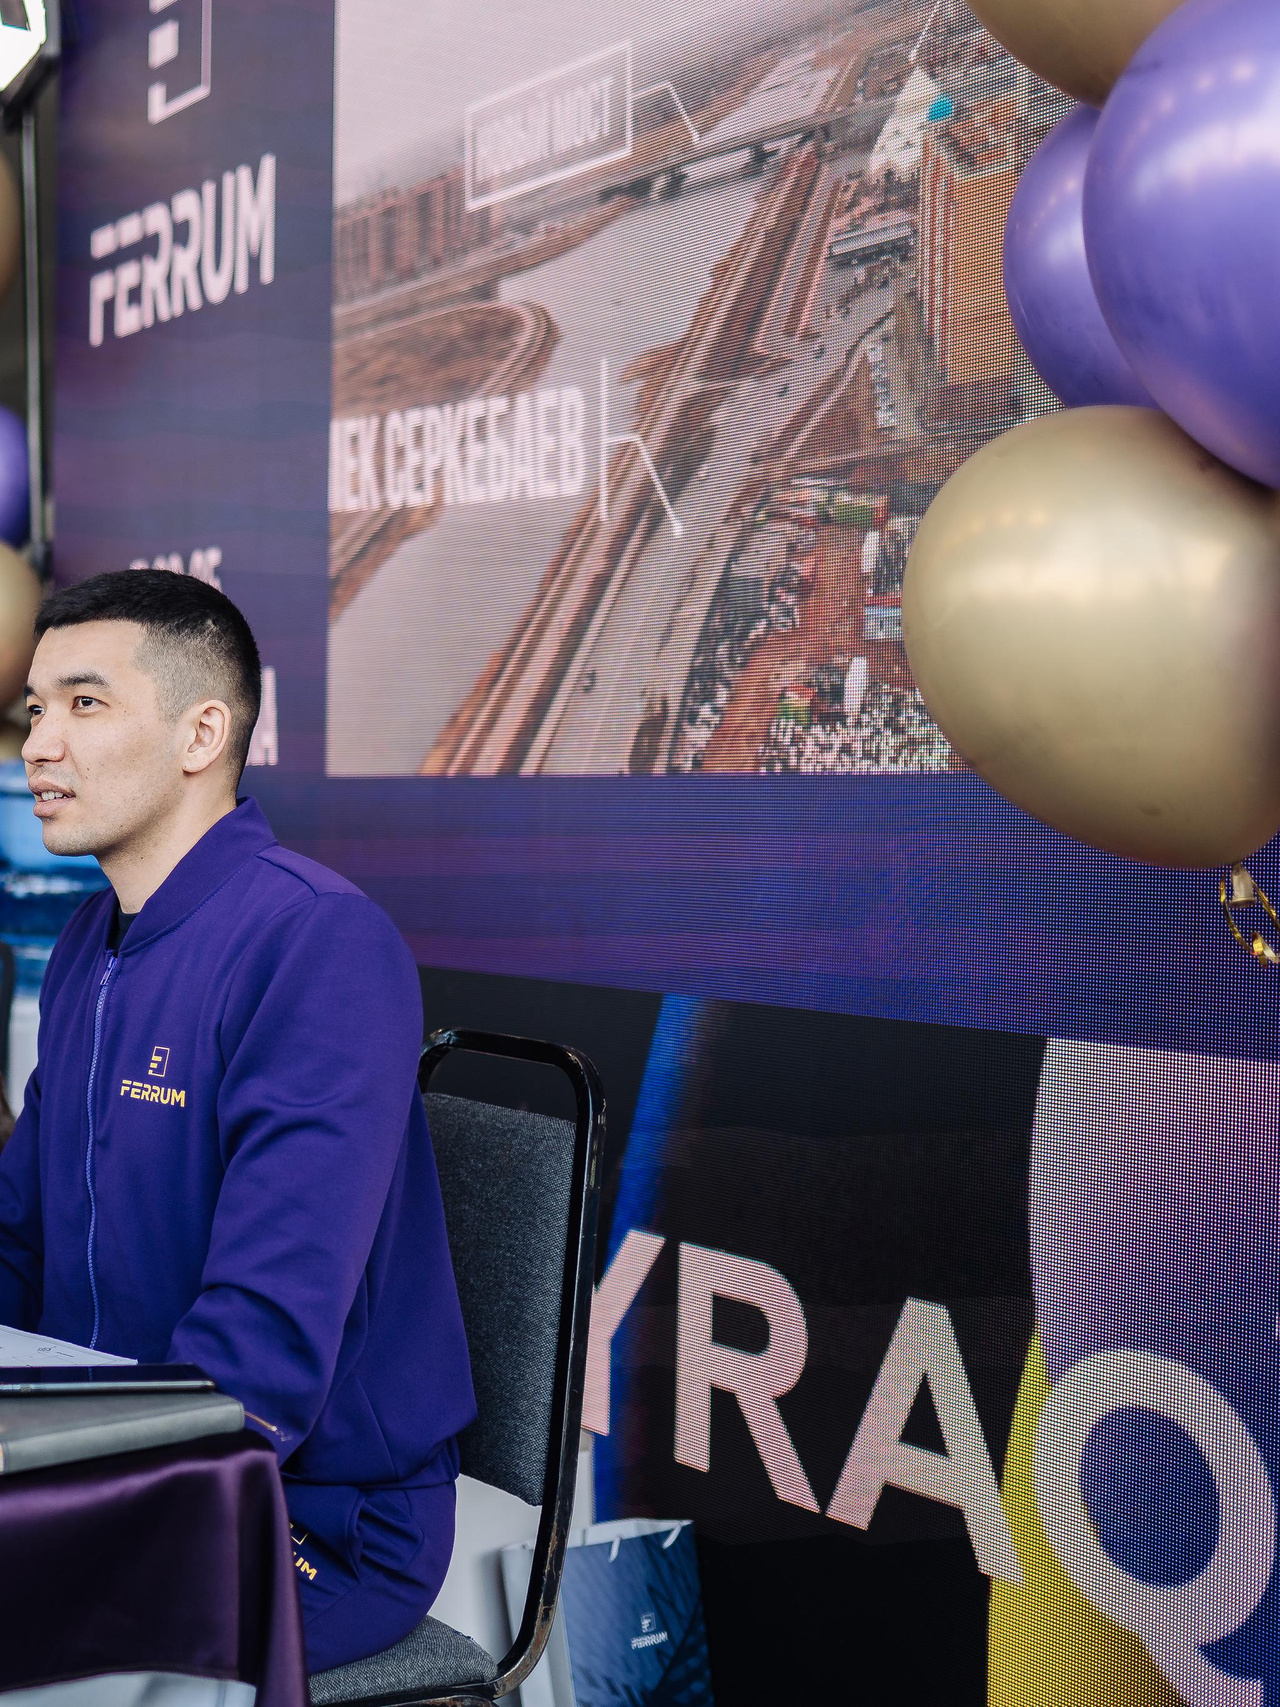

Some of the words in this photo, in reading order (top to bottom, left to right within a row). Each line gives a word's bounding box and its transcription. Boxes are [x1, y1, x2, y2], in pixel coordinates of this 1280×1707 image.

[552, 75, 614, 156] МОСТ
[89, 152, 277, 347] FERRUM
[384, 385, 586, 510] СЕРКЕБАЕВ
[120, 1079, 186, 1108] FERRUM
[630, 1630, 669, 1651] FERRUM
